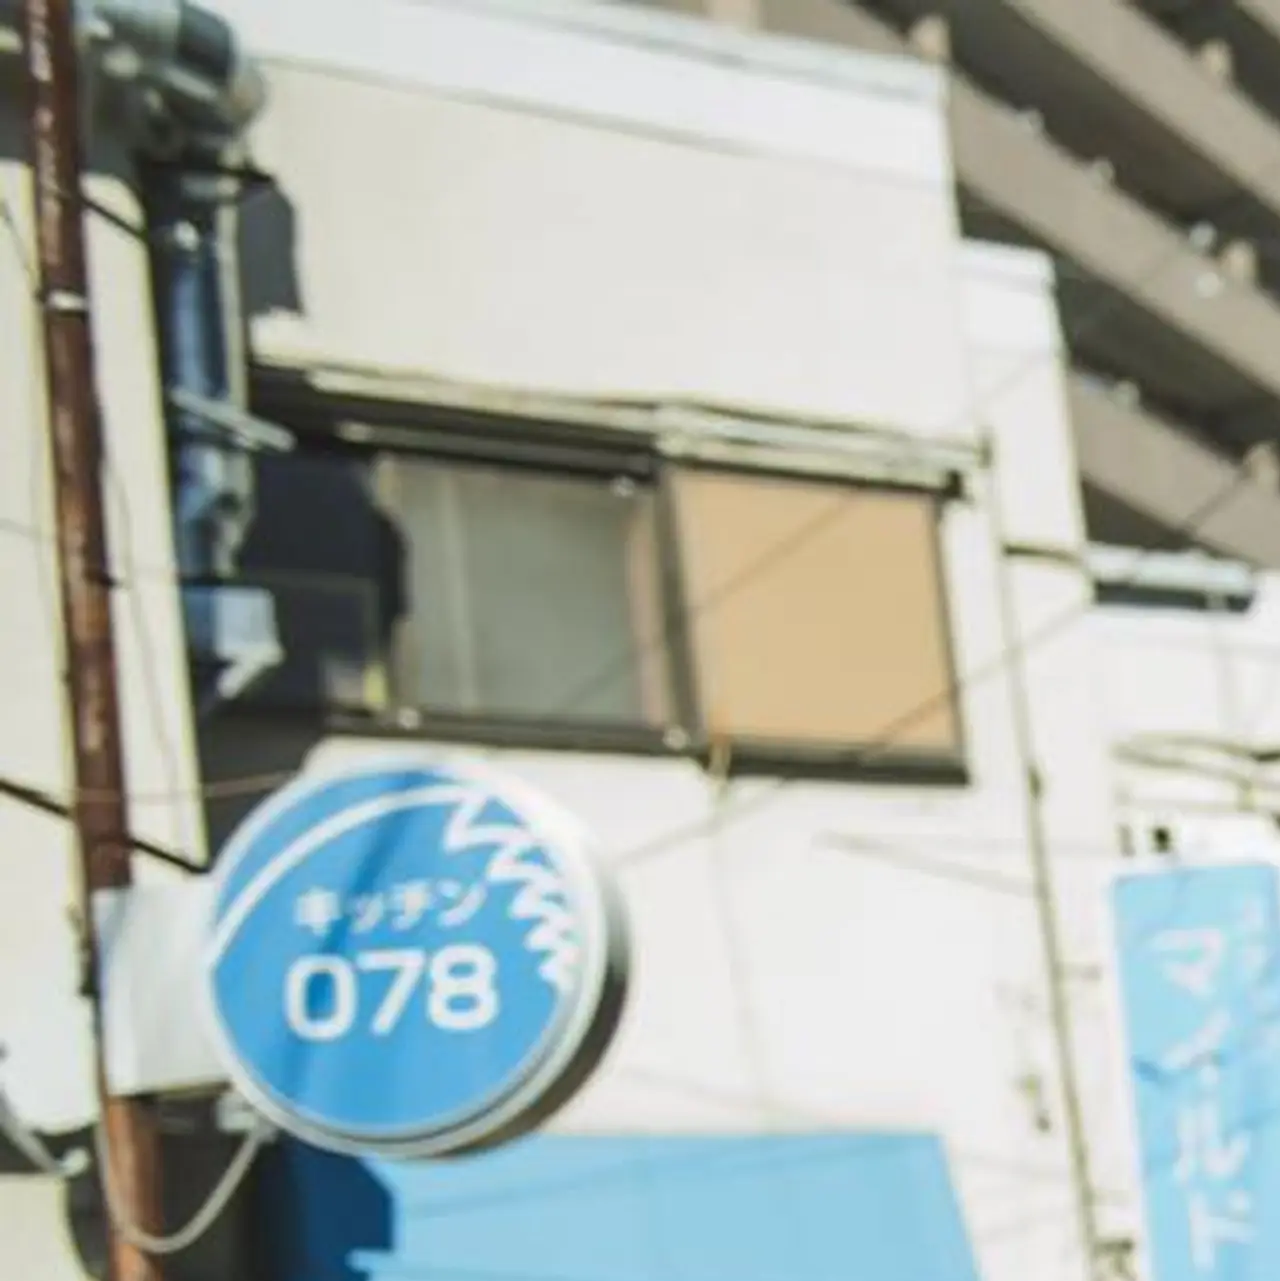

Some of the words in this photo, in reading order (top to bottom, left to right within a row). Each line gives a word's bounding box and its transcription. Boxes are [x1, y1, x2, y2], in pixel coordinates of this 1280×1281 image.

[295, 878, 487, 935] キッチン
[285, 944, 498, 1041] 078
[1145, 926, 1257, 1272] マイルド
